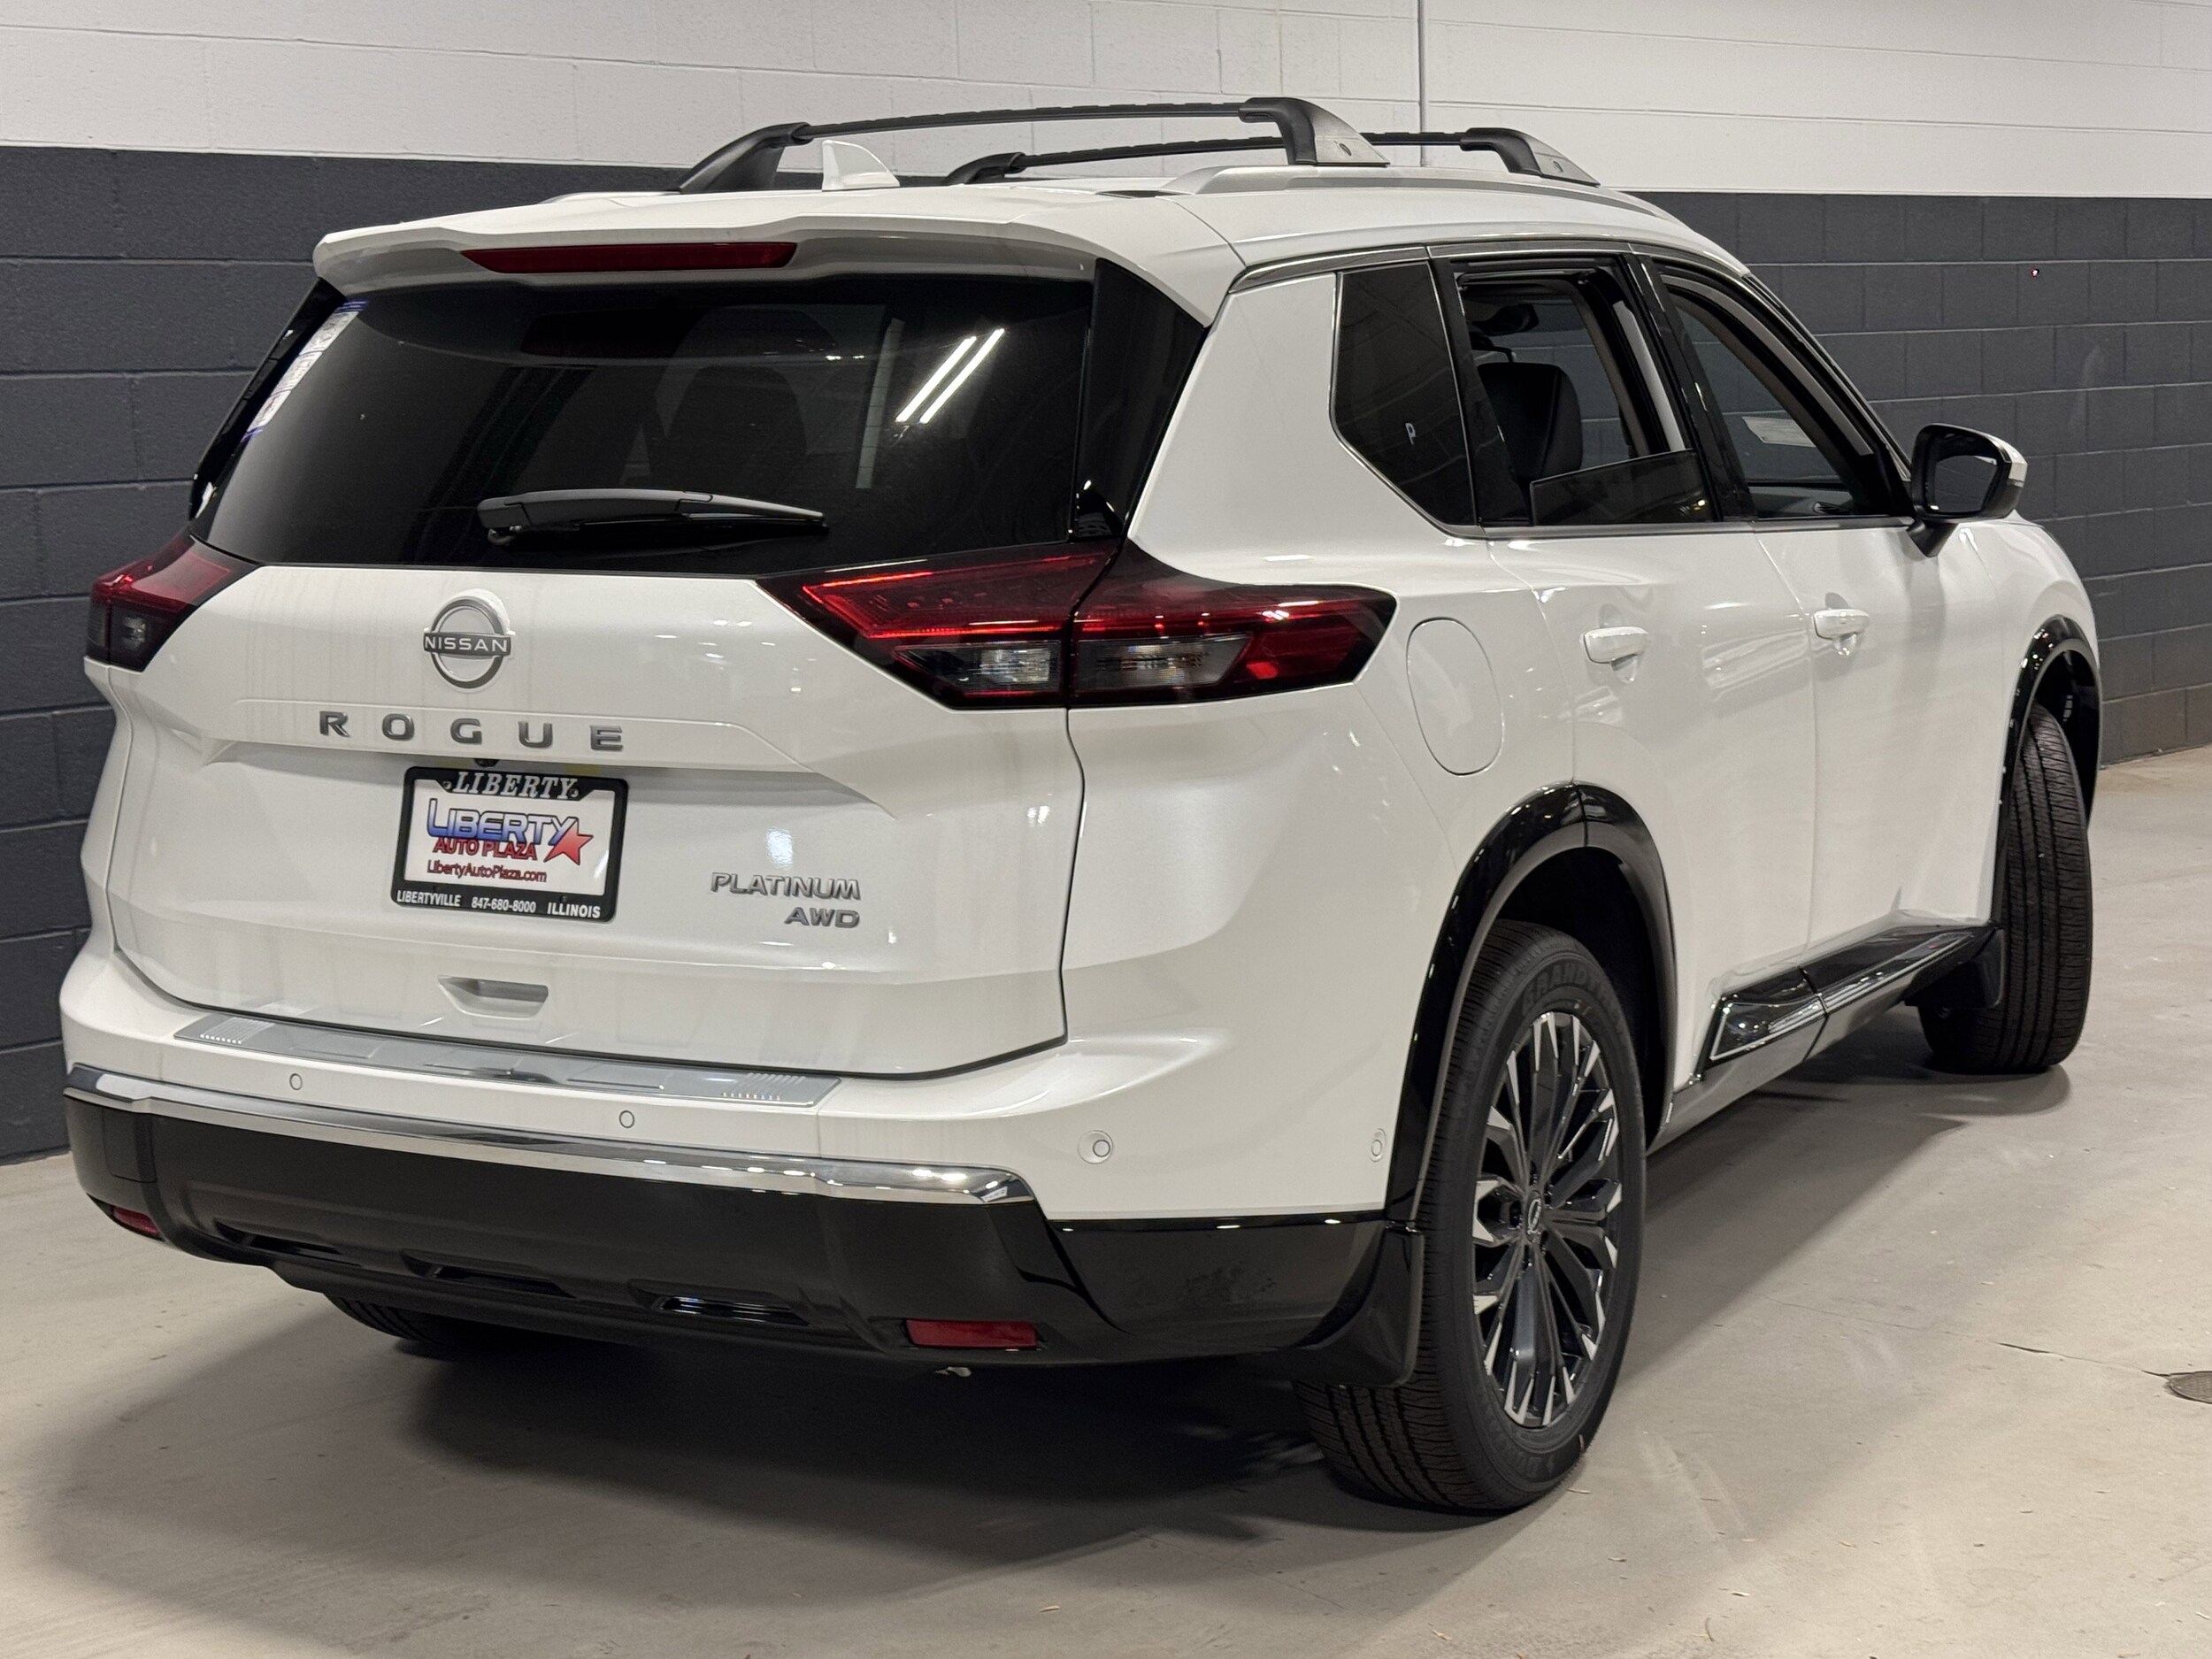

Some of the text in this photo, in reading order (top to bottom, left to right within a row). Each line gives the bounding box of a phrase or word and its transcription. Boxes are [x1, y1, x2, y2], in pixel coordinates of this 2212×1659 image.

[425, 635, 508, 653] NISSAN
[319, 710, 624, 752] ROGUE
[452, 772, 579, 800] LIBERTY
[426, 798, 580, 847] LIBERTY
[433, 837, 538, 861] AUTO PLAZA
[426, 860, 547, 883] LibertyAutoPlaza.com
[710, 872, 861, 901] PLATINUM
[397, 890, 601, 919] LIBERTYVILLE 847-680-8000 ILLINOIS
[784, 907, 860, 929] AWD
